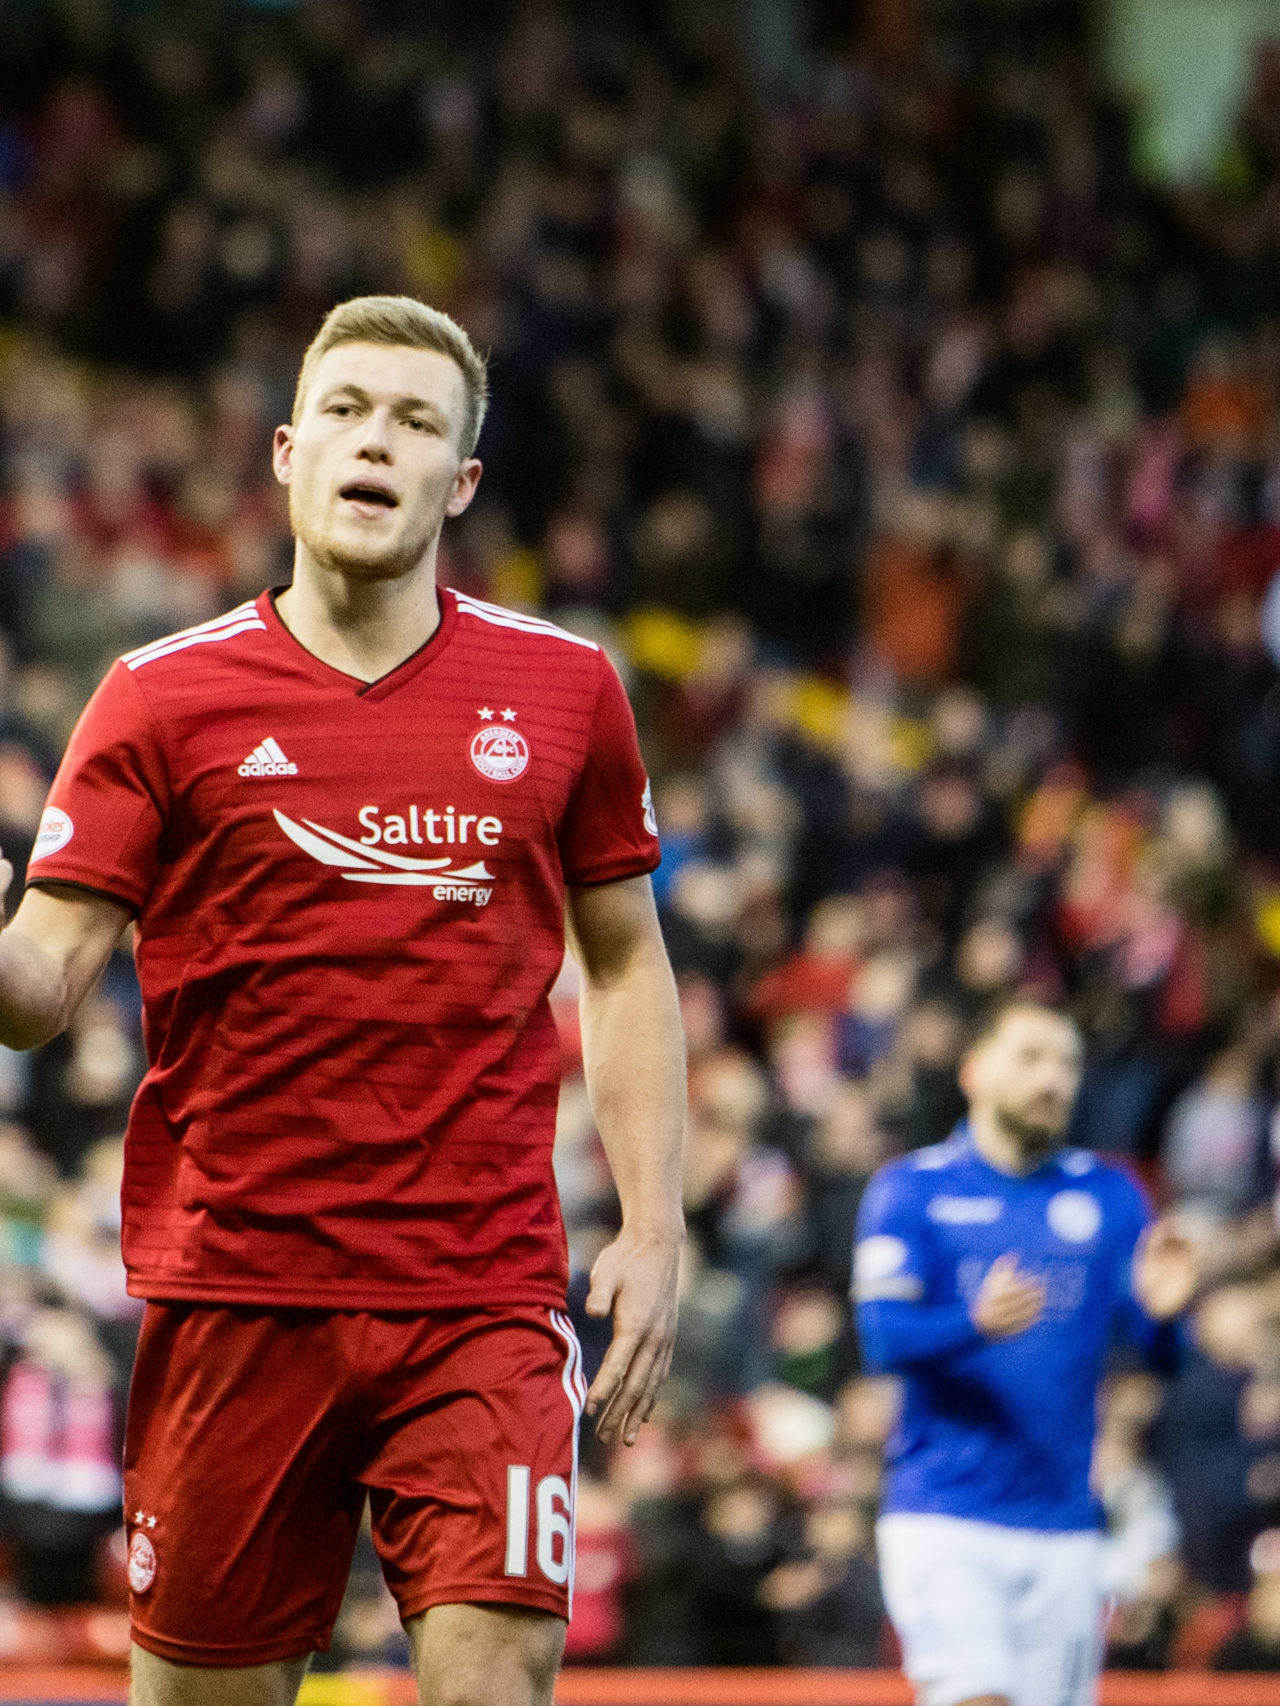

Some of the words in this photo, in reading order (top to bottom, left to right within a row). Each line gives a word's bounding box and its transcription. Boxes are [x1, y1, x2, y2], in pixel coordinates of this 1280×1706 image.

[237, 761, 299, 778] adidas
[357, 805, 503, 846] Saltire
[432, 884, 493, 907] energy
[504, 1464, 572, 1585] 16
